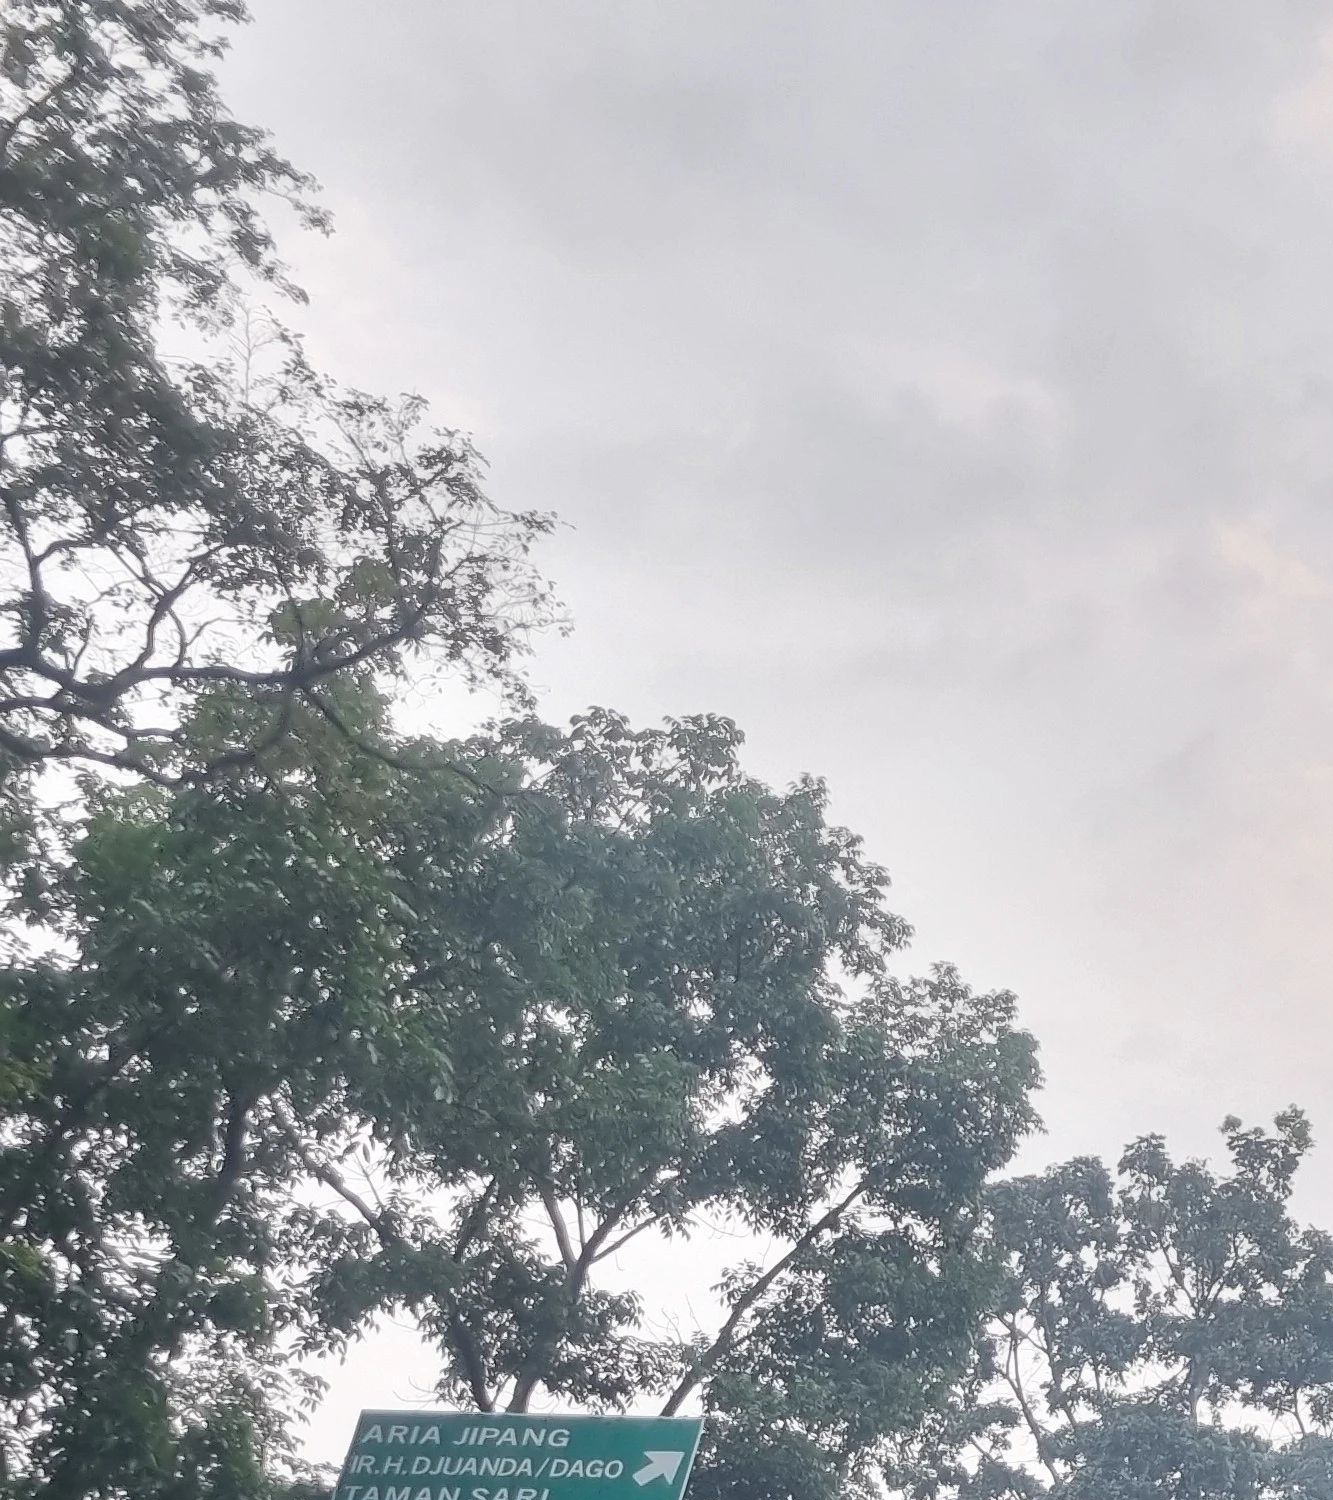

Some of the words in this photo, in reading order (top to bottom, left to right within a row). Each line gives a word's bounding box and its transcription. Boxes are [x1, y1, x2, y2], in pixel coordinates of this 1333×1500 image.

[361, 1425, 441, 1446] ARIA
[453, 1427, 570, 1448] JIPANG
[350, 1455, 624, 1479] IR.H.DJUANDA/DAGO
